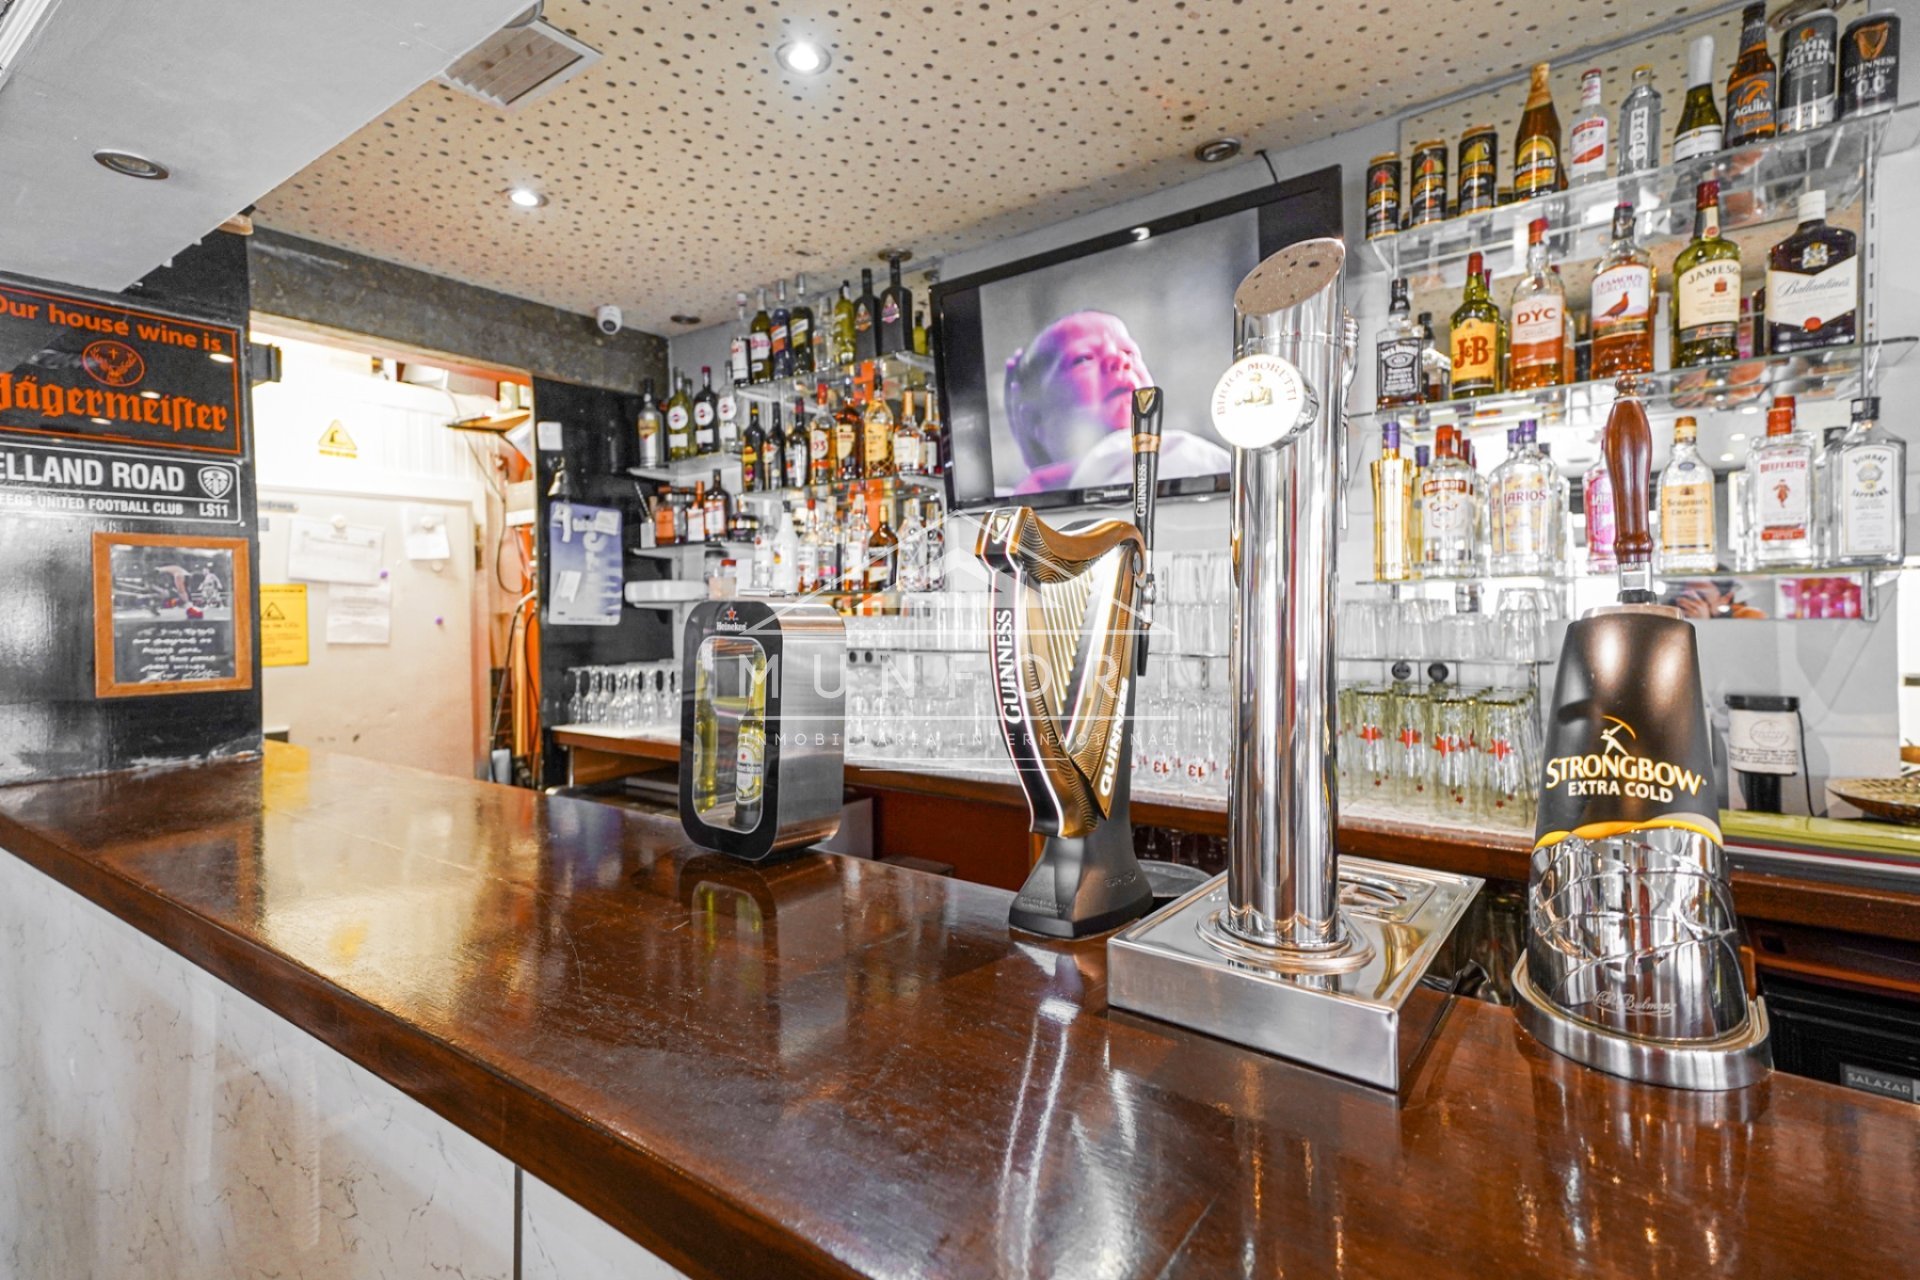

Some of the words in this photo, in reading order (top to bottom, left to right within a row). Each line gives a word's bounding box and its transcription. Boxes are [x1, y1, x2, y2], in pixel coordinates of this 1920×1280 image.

[1788, 39, 1830, 59] JOHN
[1845, 56, 1896, 77] GUINNESS
[1688, 264, 1741, 286] JAMESO
[48, 303, 130, 336] house
[136, 323, 198, 349] wine
[203, 332, 222, 353] is
[1517, 308, 1557, 325] DYC
[1453, 336, 1490, 369] J&B
[112, 460, 186, 492] ROAD
[1760, 460, 1807, 473] BEEFEATER
[1136, 463, 1147, 518] GUINNESS
[37, 497, 85, 510] UNITED
[88, 499, 151, 514] FOOTBALL
[153, 501, 184, 516] CLUB
[198, 502, 229, 518] LS11
[716, 621, 757, 632] Heineken
[996, 610, 1022, 725] GUINNESS
[1100, 677, 1129, 797] GUINNESS
[1545, 753, 1702, 796] STRONGBOW
[1568, 780, 1621, 797] EXTRA
[1624, 781, 1674, 804] COLD
[1846, 1072, 1912, 1095] SALAZAR
